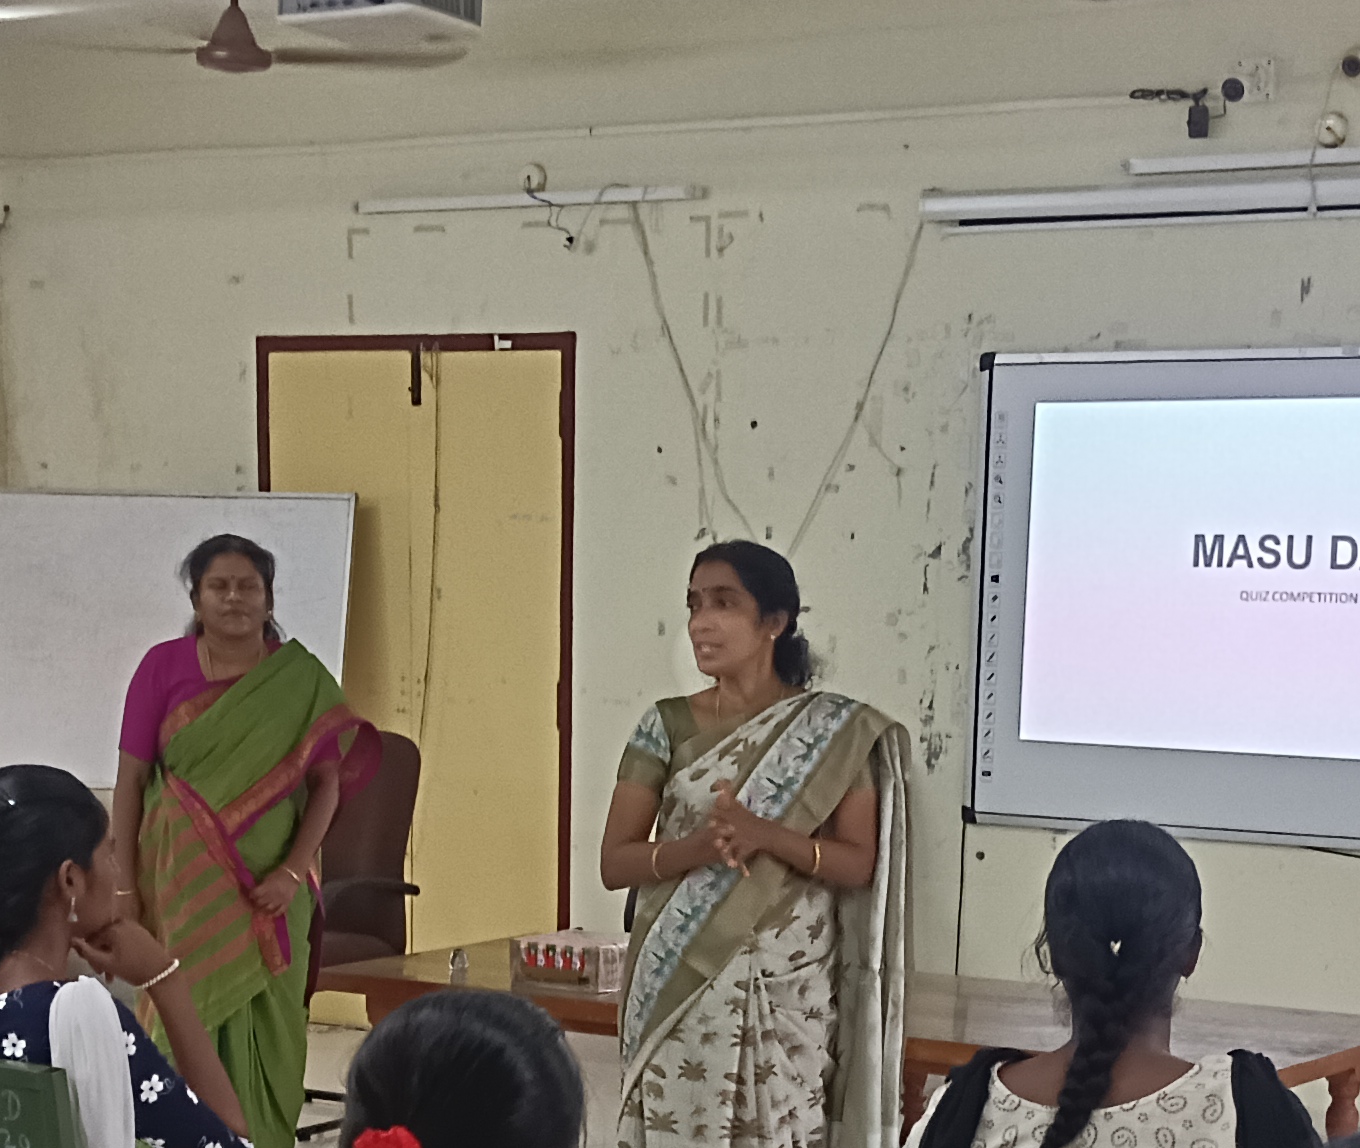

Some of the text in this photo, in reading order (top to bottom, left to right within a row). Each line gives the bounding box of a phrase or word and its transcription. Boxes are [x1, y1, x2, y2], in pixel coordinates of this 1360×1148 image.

[1193, 533, 1313, 570] MASU
[1240, 590, 1359, 604] QUIZ COMPETITION
